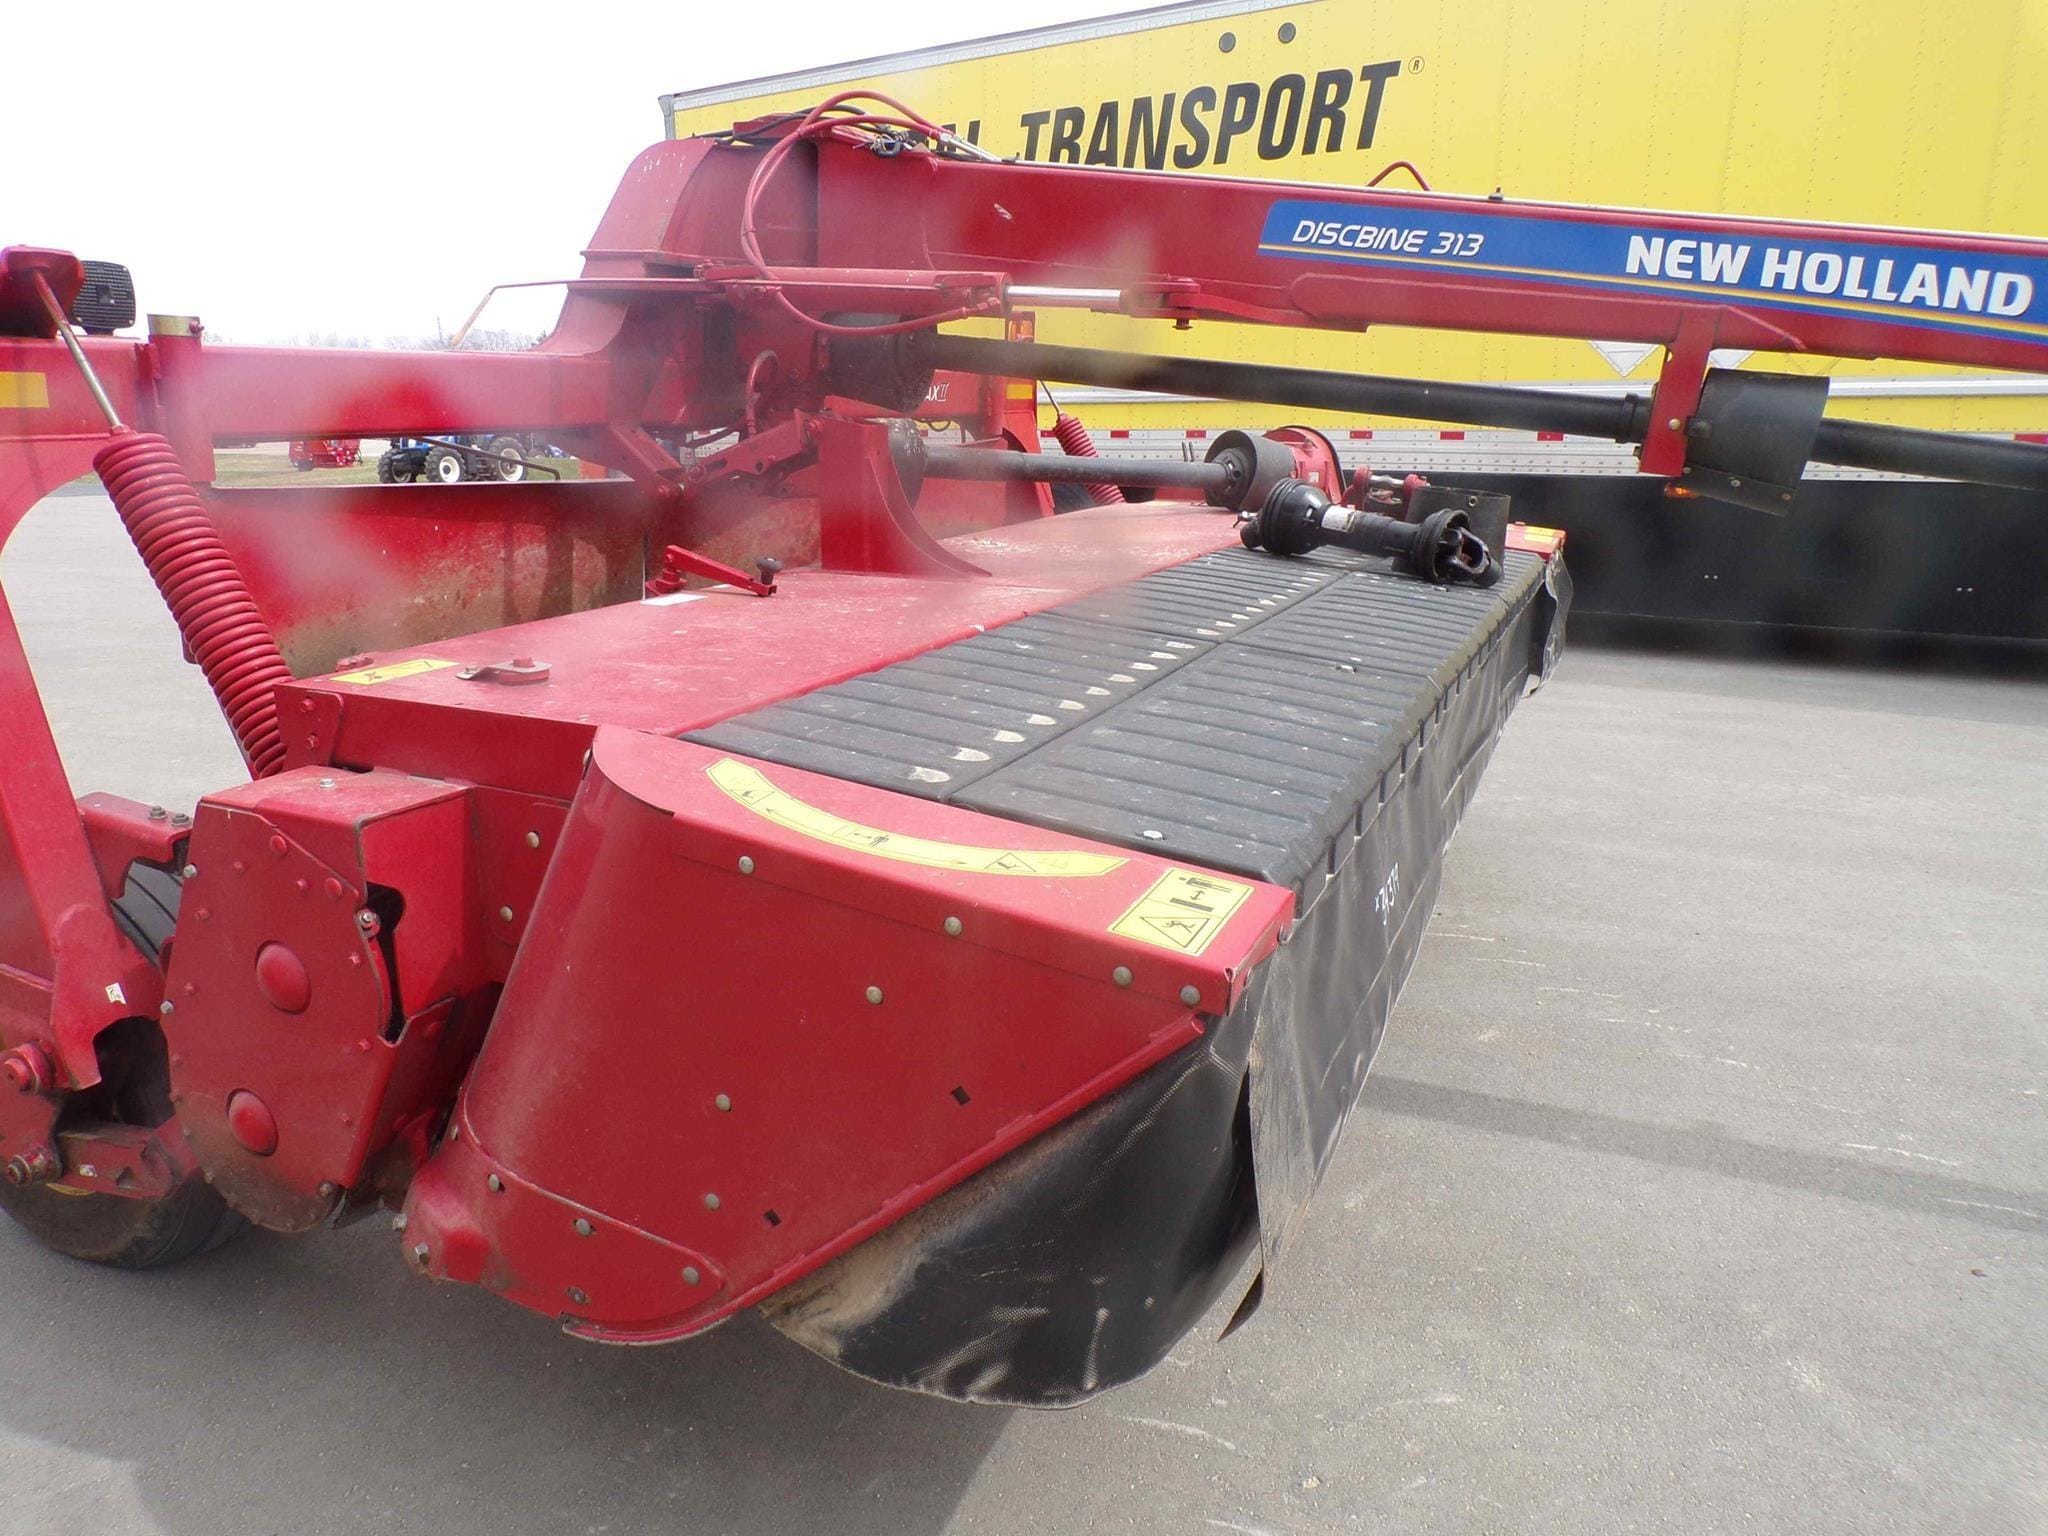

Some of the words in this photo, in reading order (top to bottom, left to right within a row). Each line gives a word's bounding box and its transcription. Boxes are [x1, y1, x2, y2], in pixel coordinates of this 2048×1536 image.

[1020, 59, 1402, 171] TRANSPORT
[1292, 219, 1429, 253] DISCBINE
[1430, 231, 1485, 257] 313
[1625, 235, 1751, 284] NEW
[1759, 248, 2034, 318] HOLLAND
